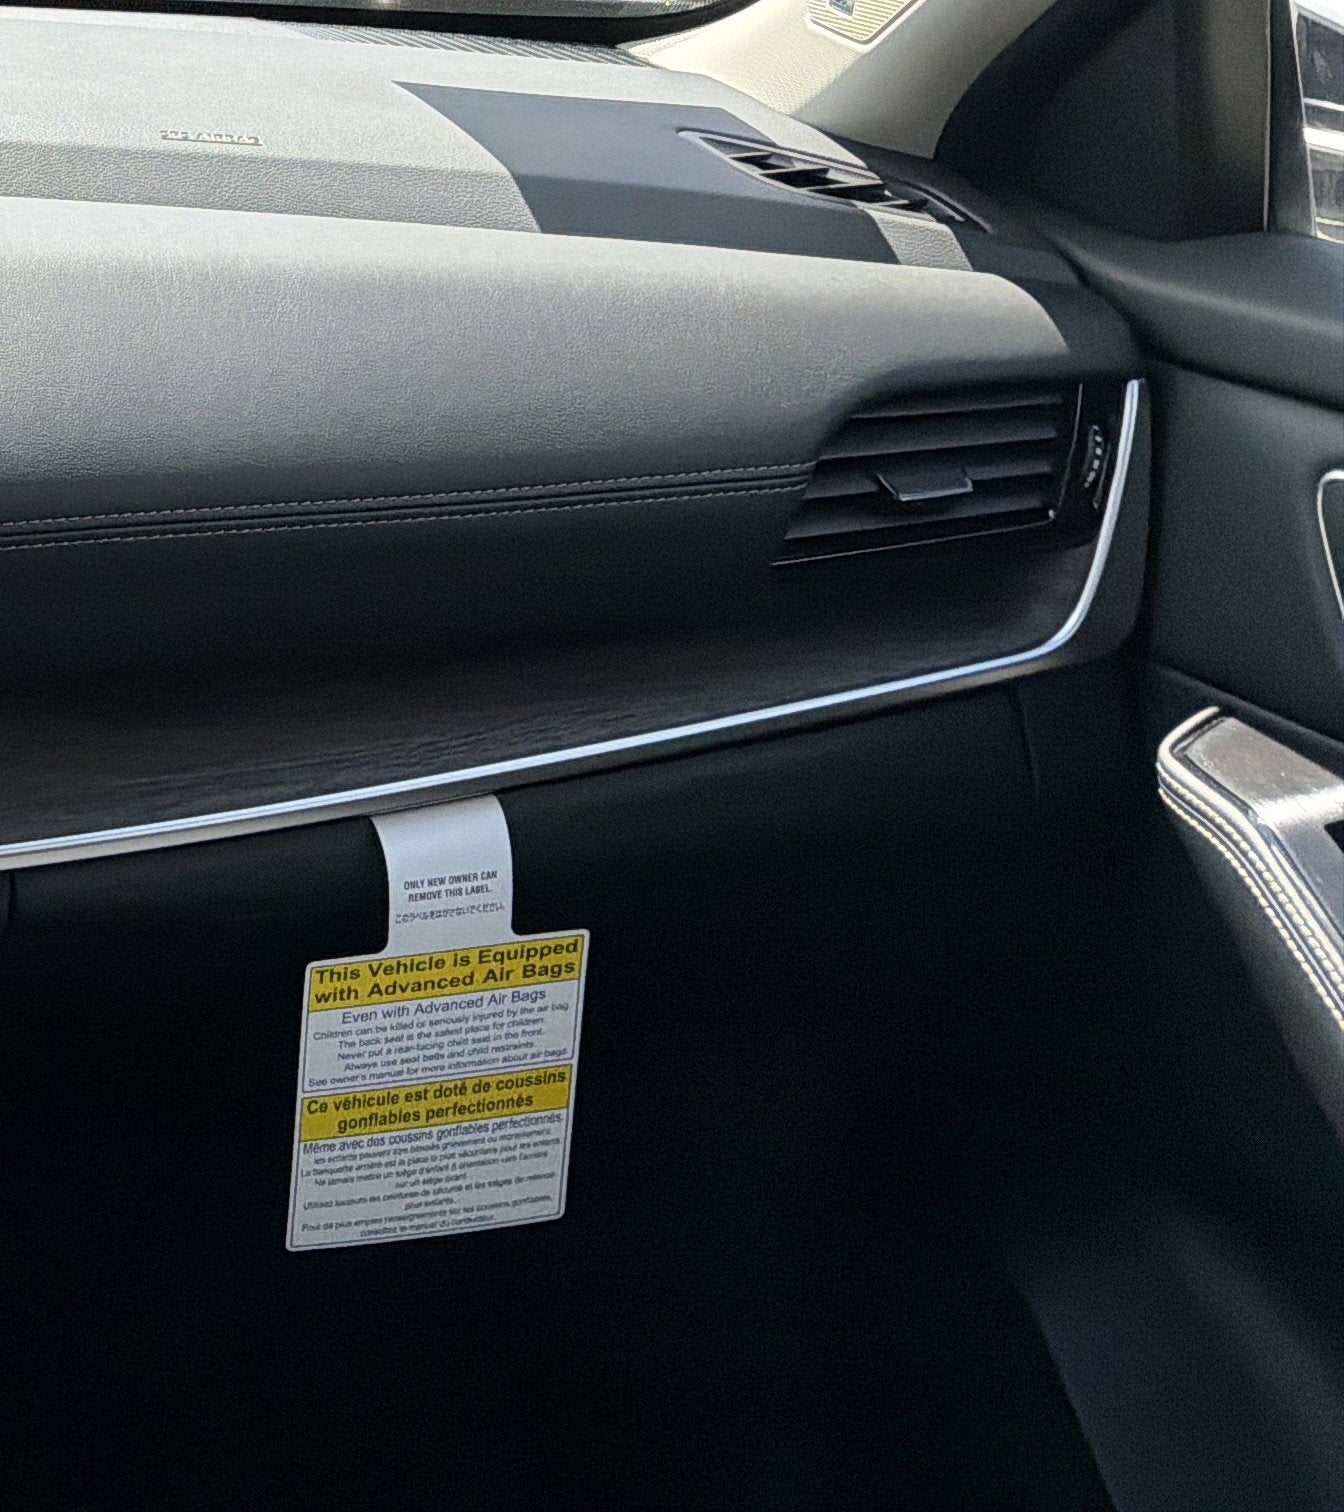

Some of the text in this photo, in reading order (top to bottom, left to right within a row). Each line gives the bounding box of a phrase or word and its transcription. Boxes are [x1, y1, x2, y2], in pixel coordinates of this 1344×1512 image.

[403, 869, 497, 890] ONLY NEW OWNER CAN
[408, 890, 442, 902] REMOVE
[444, 887, 462, 897] THIS
[313, 958, 576, 1005] with Advanced Air Bags
[315, 939, 578, 984] This Vehicle is Equipped
[341, 987, 546, 1024] Even with Advanced Air Bags
[306, 1068, 567, 1115] Ce véhicule est doté de coussins
[337, 1093, 534, 1133] gonflables perfectionnés
